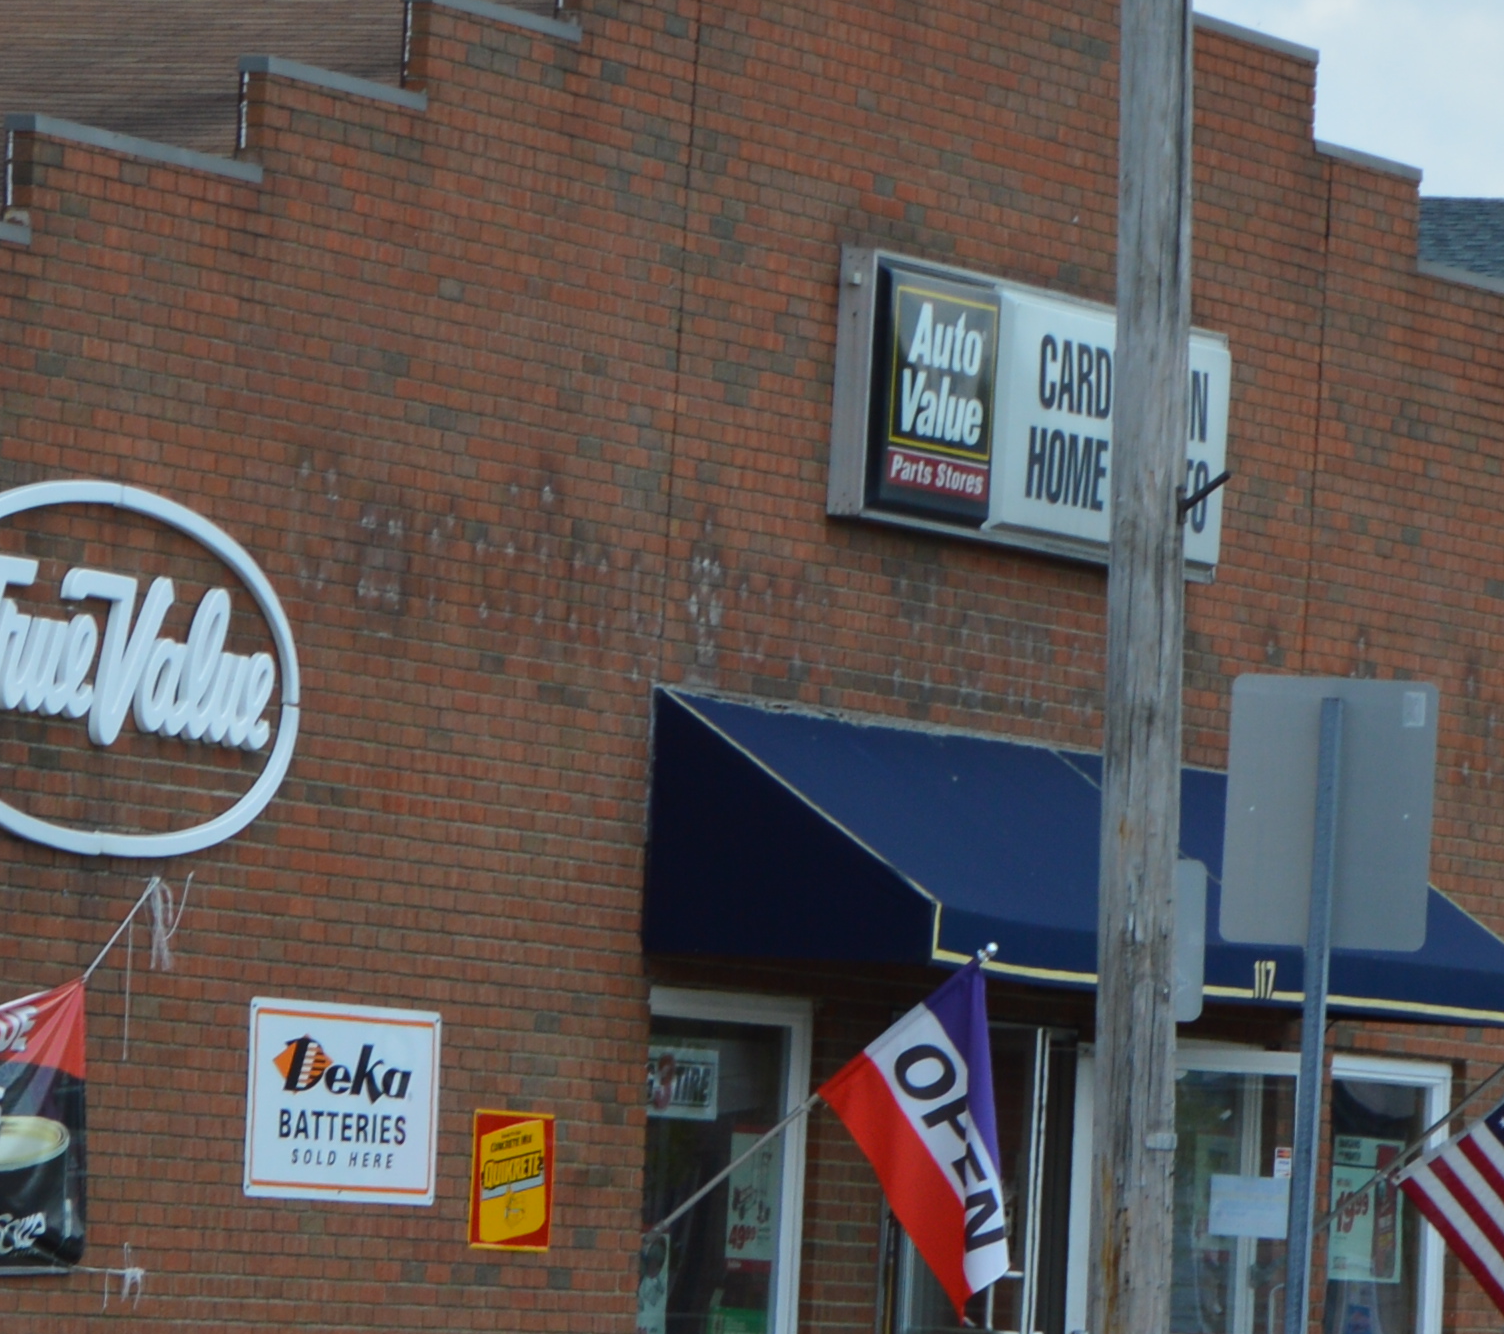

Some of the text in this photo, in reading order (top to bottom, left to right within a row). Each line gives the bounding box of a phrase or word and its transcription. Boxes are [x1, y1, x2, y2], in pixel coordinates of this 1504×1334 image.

[907, 302, 984, 376] Auto
[901, 368, 984, 446] Value
[890, 455, 984, 495] Parts Stores
[1025, 426, 1109, 512] HOME
[60, 567, 276, 751] Value
[1253, 960, 1277, 1000] 117
[282, 1037, 412, 1105] Deka
[278, 1108, 407, 1146] BATTERIES
[290, 1148, 395, 1169] SOLD HERE
